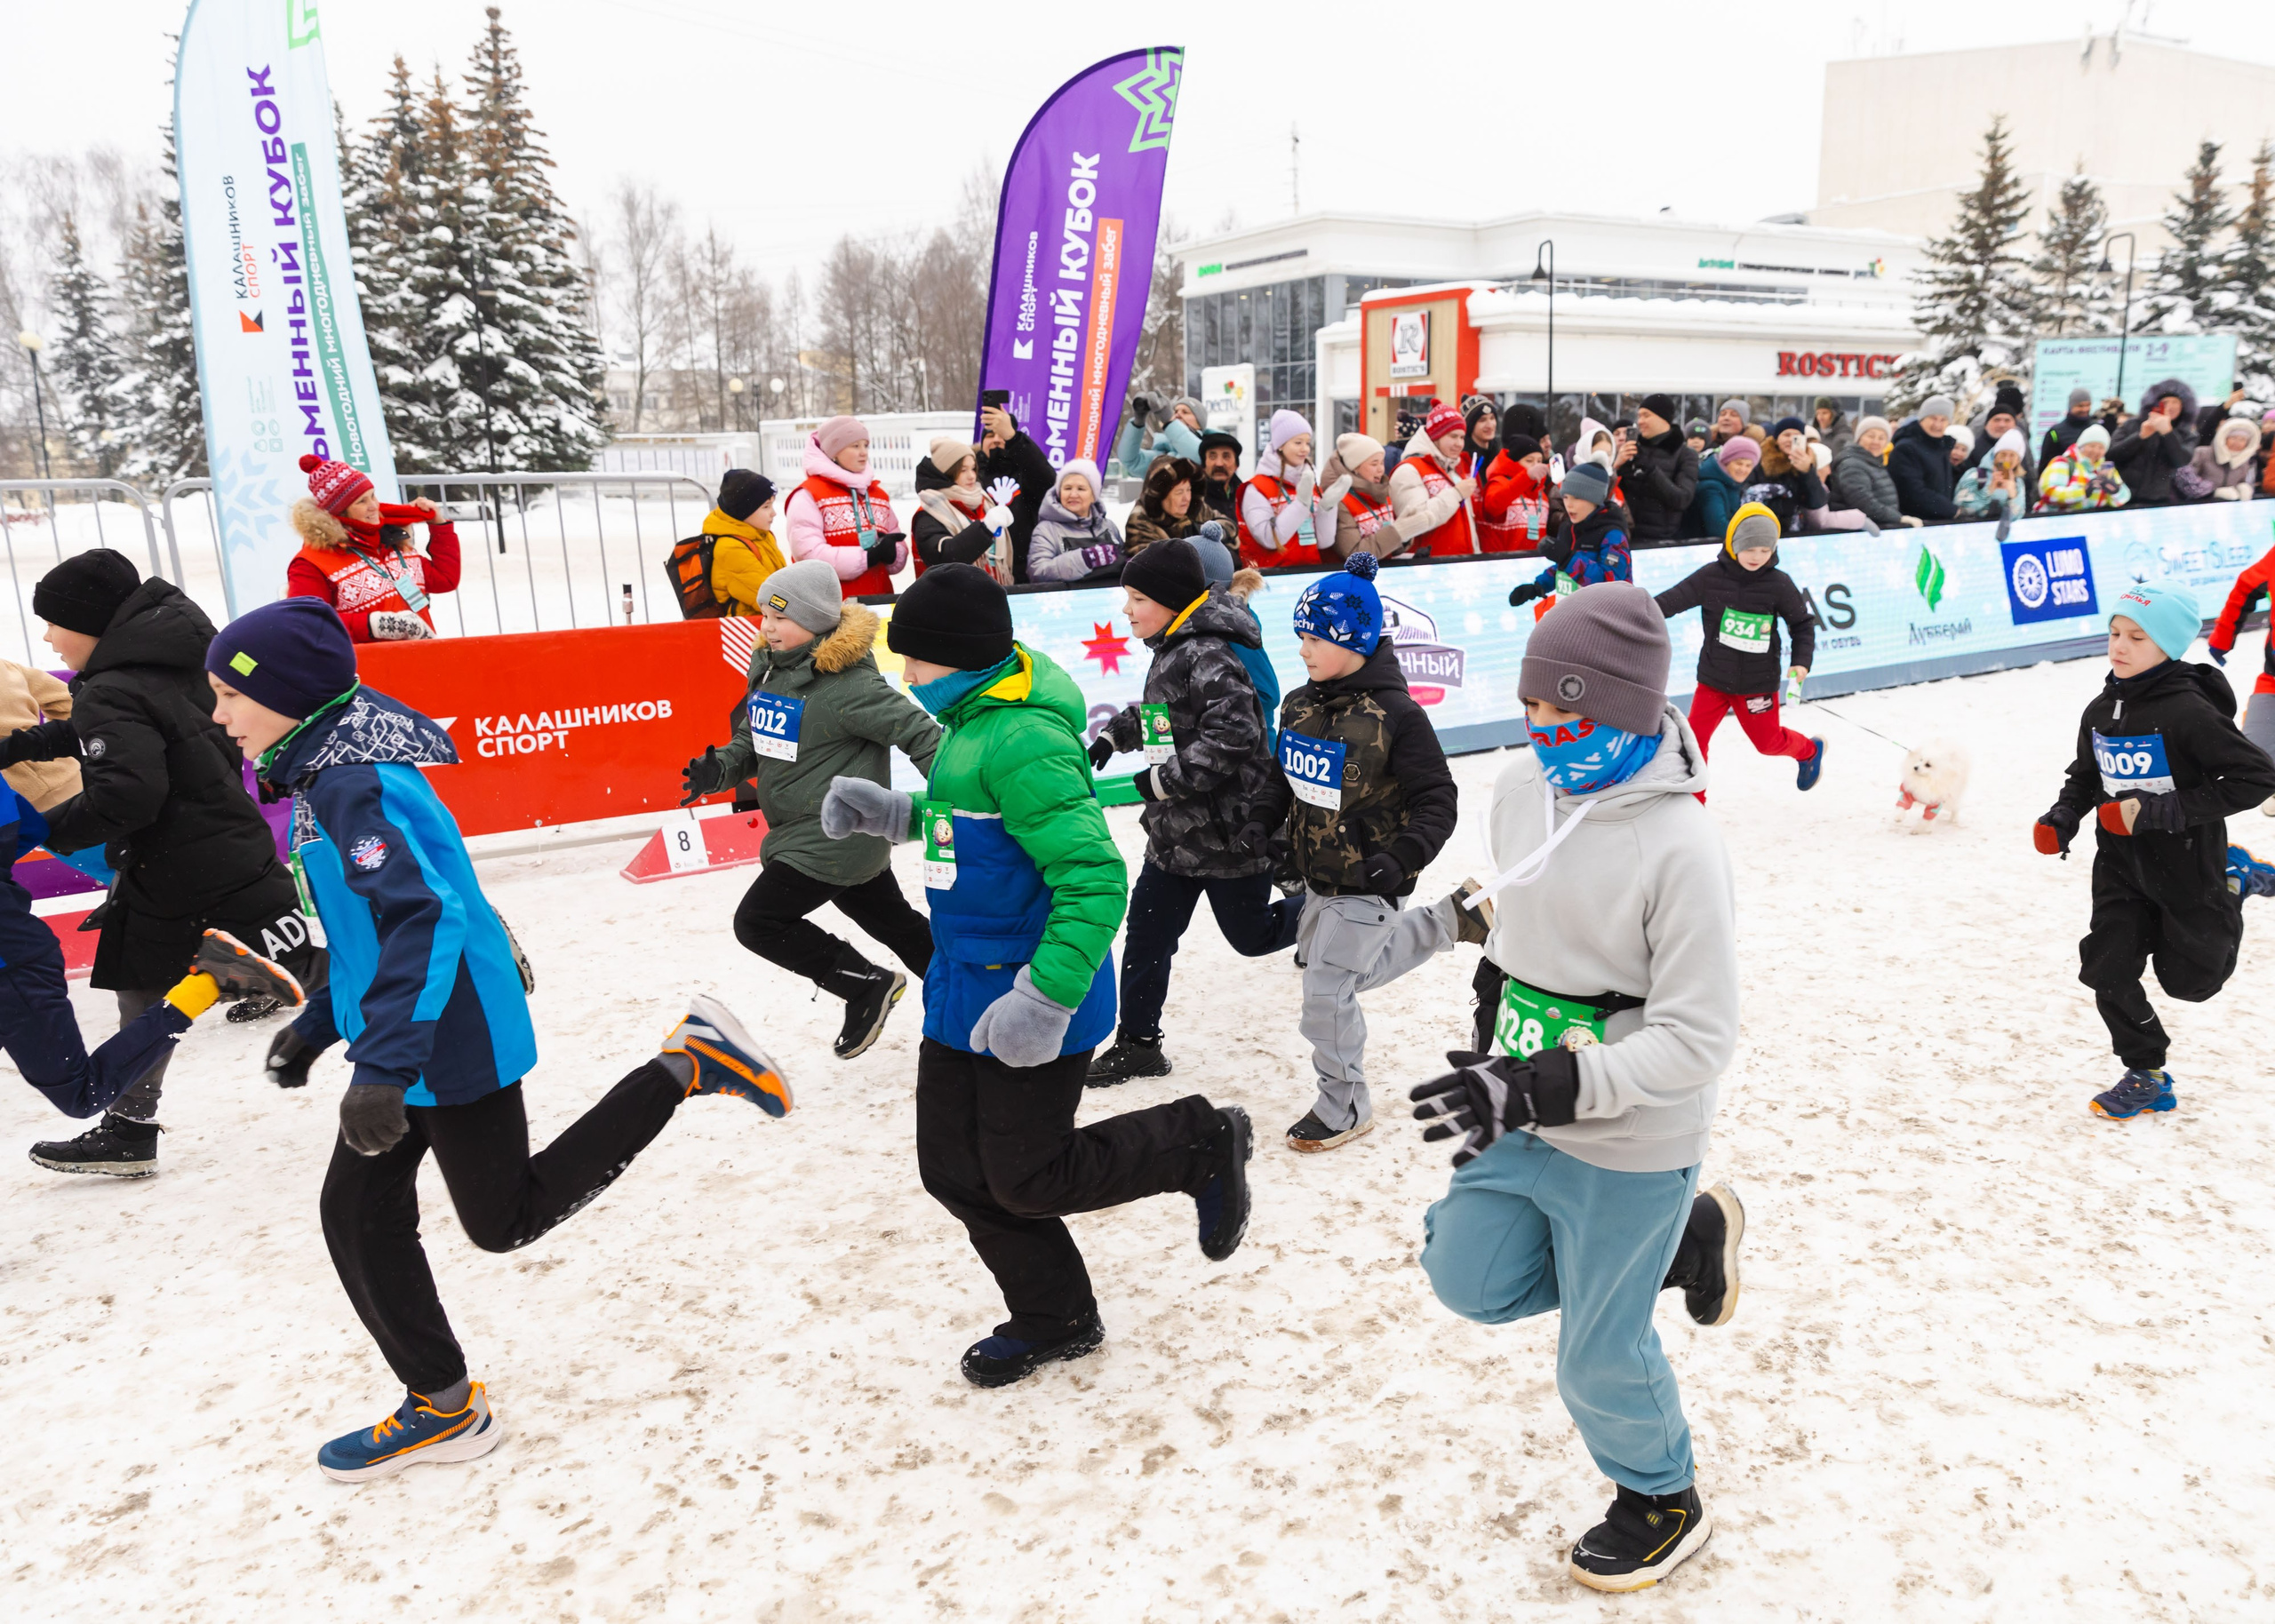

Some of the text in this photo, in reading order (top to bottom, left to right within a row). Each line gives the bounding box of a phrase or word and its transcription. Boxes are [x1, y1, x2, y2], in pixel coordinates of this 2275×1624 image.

[222, 175, 248, 299] КАЛАШНИКОВ
[242, 243, 261, 298] СПОРТ
[246, 63, 331, 461] ЬМЕННЫЙ КУБОК
[1017, 231, 1038, 331] КАЛАШНИКОВ
[296, 152, 366, 466] Новогодний многодневный забег
[1025, 285, 1038, 332] СПОРТ
[1045, 151, 1100, 470] ЬМЕННЫЙ КУБОК
[1082, 226, 1117, 459] овогодний многодневный забег
[2045, 547, 2085, 578] LUMO
[1557, 578, 1572, 595] 931
[2050, 577, 2089, 606] STARS
[1294, 618, 1315, 632] ochi
[1802, 583, 1856, 633] AS
[1724, 617, 1756, 639] 934
[1397, 651, 1460, 679] ЧНЫЙ
[474, 699, 674, 737] КАЛАШНИКОВ
[750, 705, 787, 736] 1012
[1141, 719, 1150, 742] 5
[1526, 717, 1601, 747] RAS
[476, 730, 570, 758] СПОРТ
[1284, 746, 1331, 783] 1002
[2097, 749, 2153, 776] 1009
[677, 830, 690, 852] 8
[1499, 998, 1545, 1058] 928
